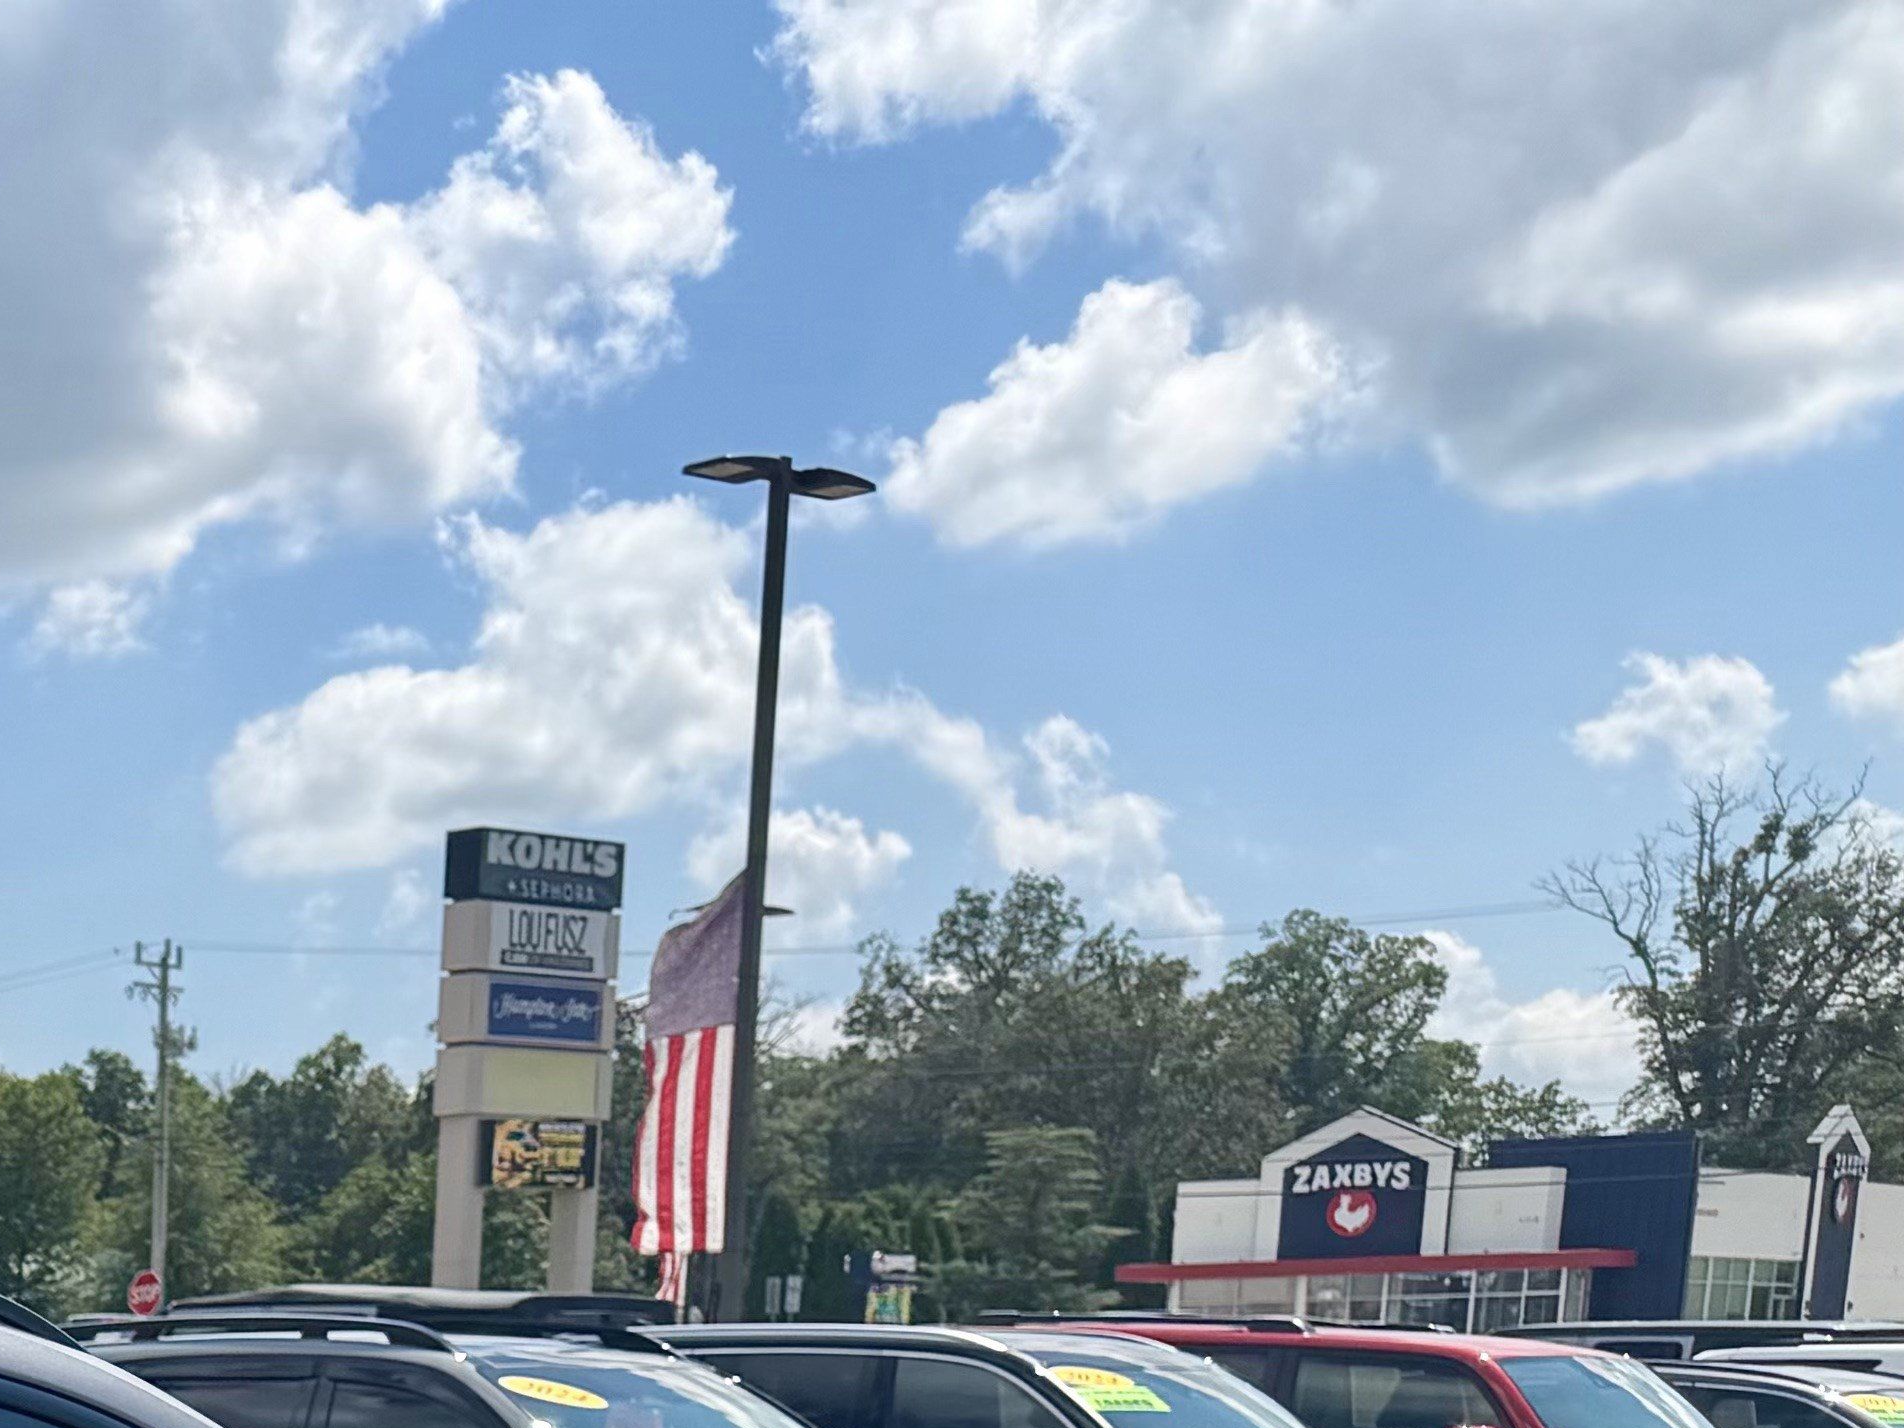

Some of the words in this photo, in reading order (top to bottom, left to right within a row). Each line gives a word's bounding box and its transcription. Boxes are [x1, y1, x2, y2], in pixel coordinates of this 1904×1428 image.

[487, 831, 618, 878] KOHL'S
[509, 909, 541, 950] LOU
[1292, 1161, 1411, 1194] ZAXBYS
[130, 1283, 161, 1305] STOP
